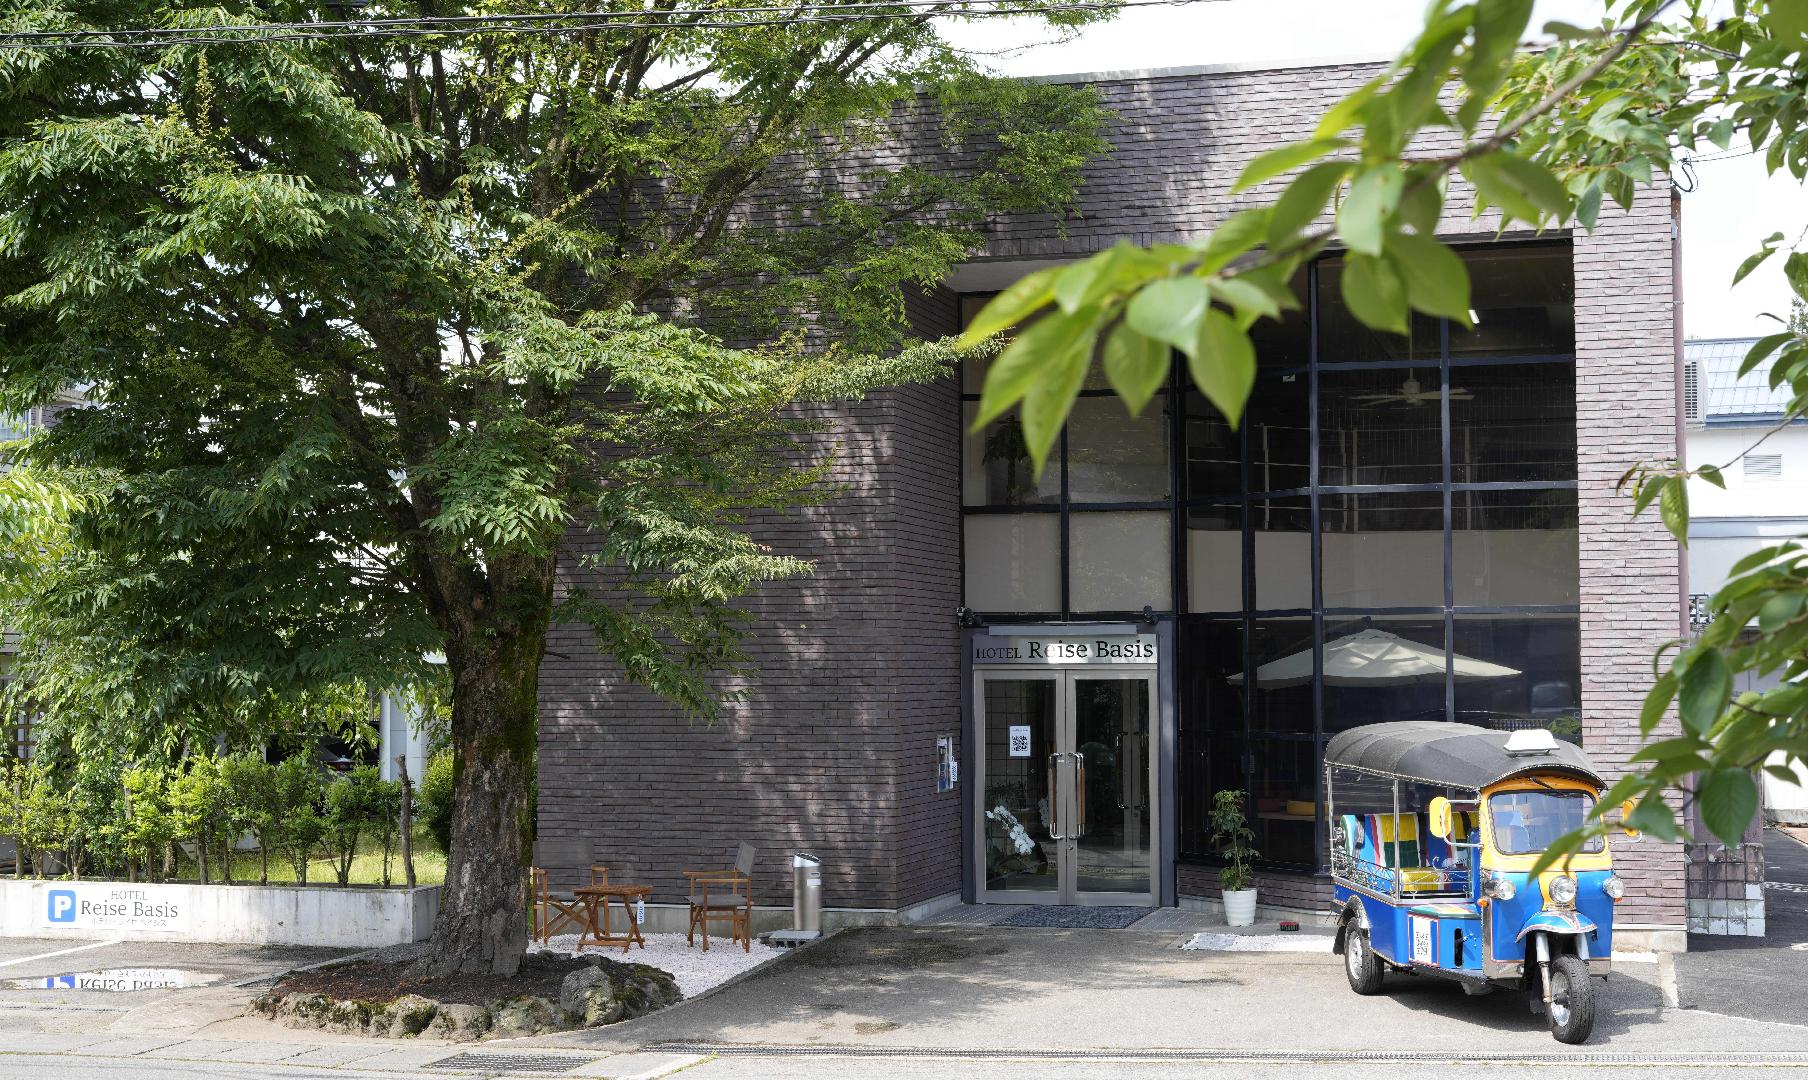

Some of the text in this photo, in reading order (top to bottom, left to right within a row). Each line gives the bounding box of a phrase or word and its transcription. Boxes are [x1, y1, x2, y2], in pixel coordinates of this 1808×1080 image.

[975, 639, 1154, 659] HOTEL Reise Basis
[110, 890, 149, 901] HOTEL
[81, 900, 179, 918] Reise Basis
